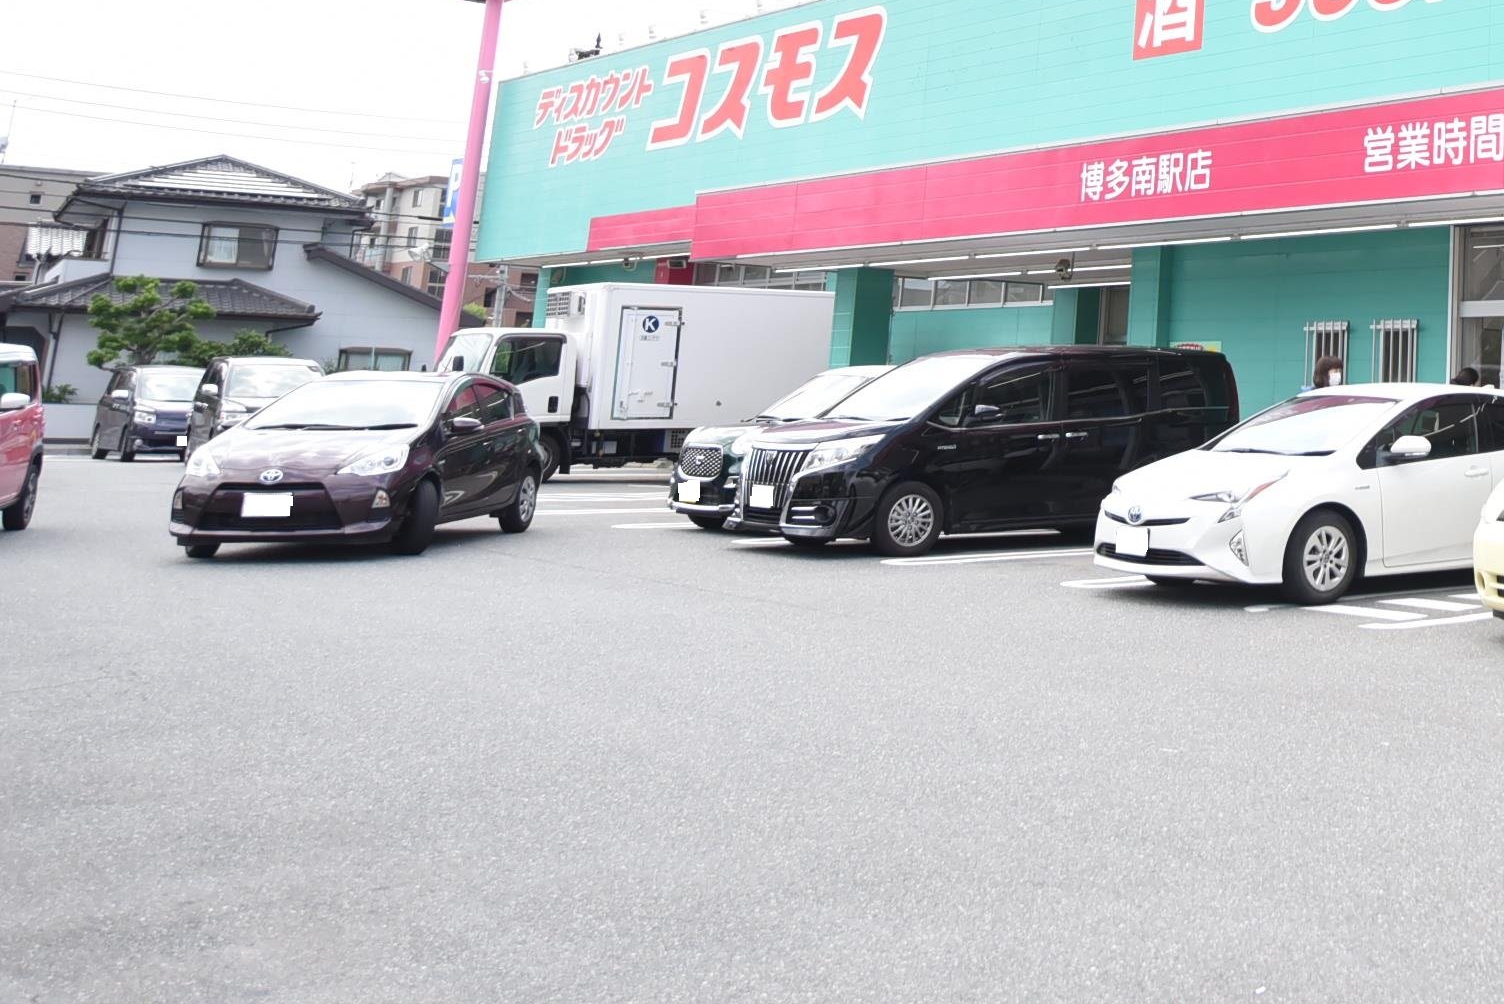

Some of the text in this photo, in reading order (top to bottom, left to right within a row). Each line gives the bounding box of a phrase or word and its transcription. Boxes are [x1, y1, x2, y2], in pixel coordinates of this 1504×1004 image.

[532, 66, 655, 129] ディスカウント
[646, 5, 887, 151] コスモス
[548, 115, 625, 168] ドラッグ
[1363, 113, 1504, 173] 営業時間
[1080, 150, 1212, 202] 博多南駅店
[645, 318, 656, 331] K
